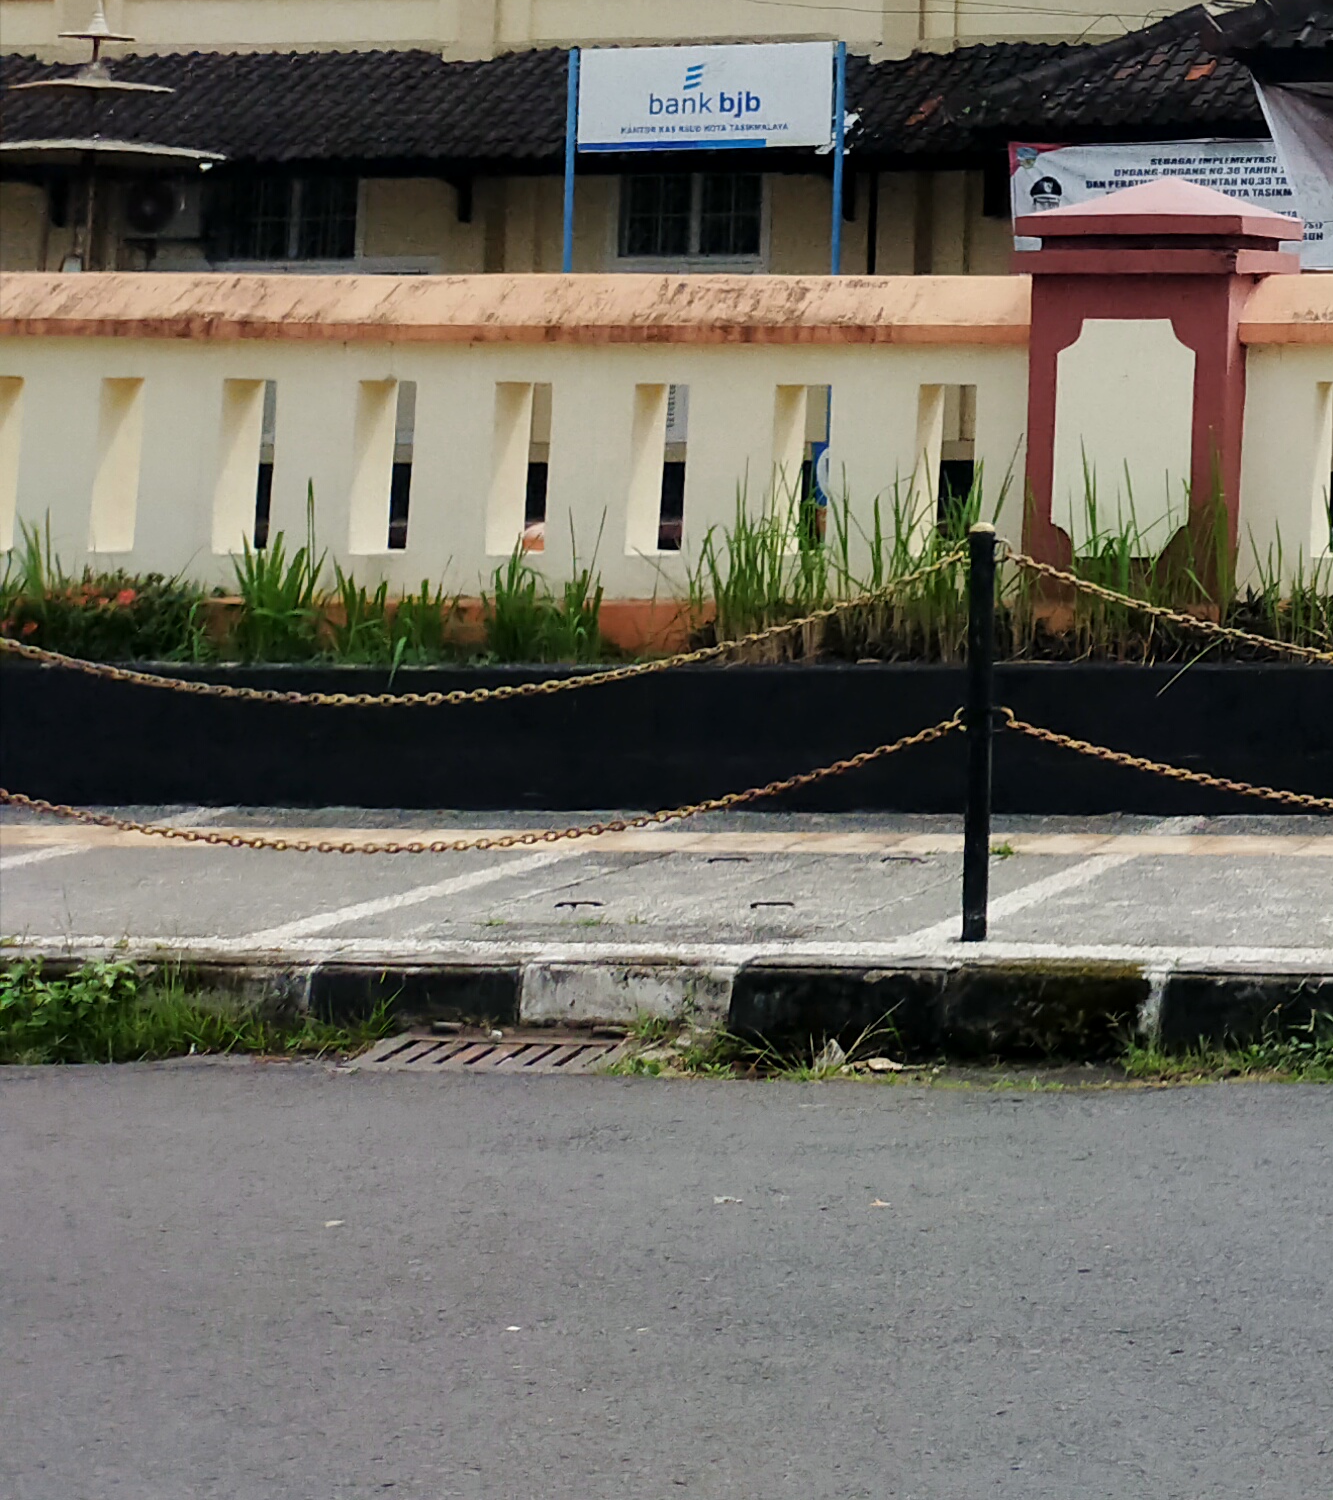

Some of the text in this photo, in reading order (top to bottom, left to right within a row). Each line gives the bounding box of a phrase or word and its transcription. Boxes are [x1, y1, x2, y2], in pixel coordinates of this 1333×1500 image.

[649, 91, 761, 118] bank bjb
[658, 125, 676, 133] KAS
[703, 123, 727, 132] KOTA
[729, 122, 789, 132] TASIKMALAYA
[1150, 155, 1277, 165] SEBAGAI IMPLEMENTASI
[1243, 165, 1278, 174] TAHUN
[1085, 180, 1106, 189] DAN
